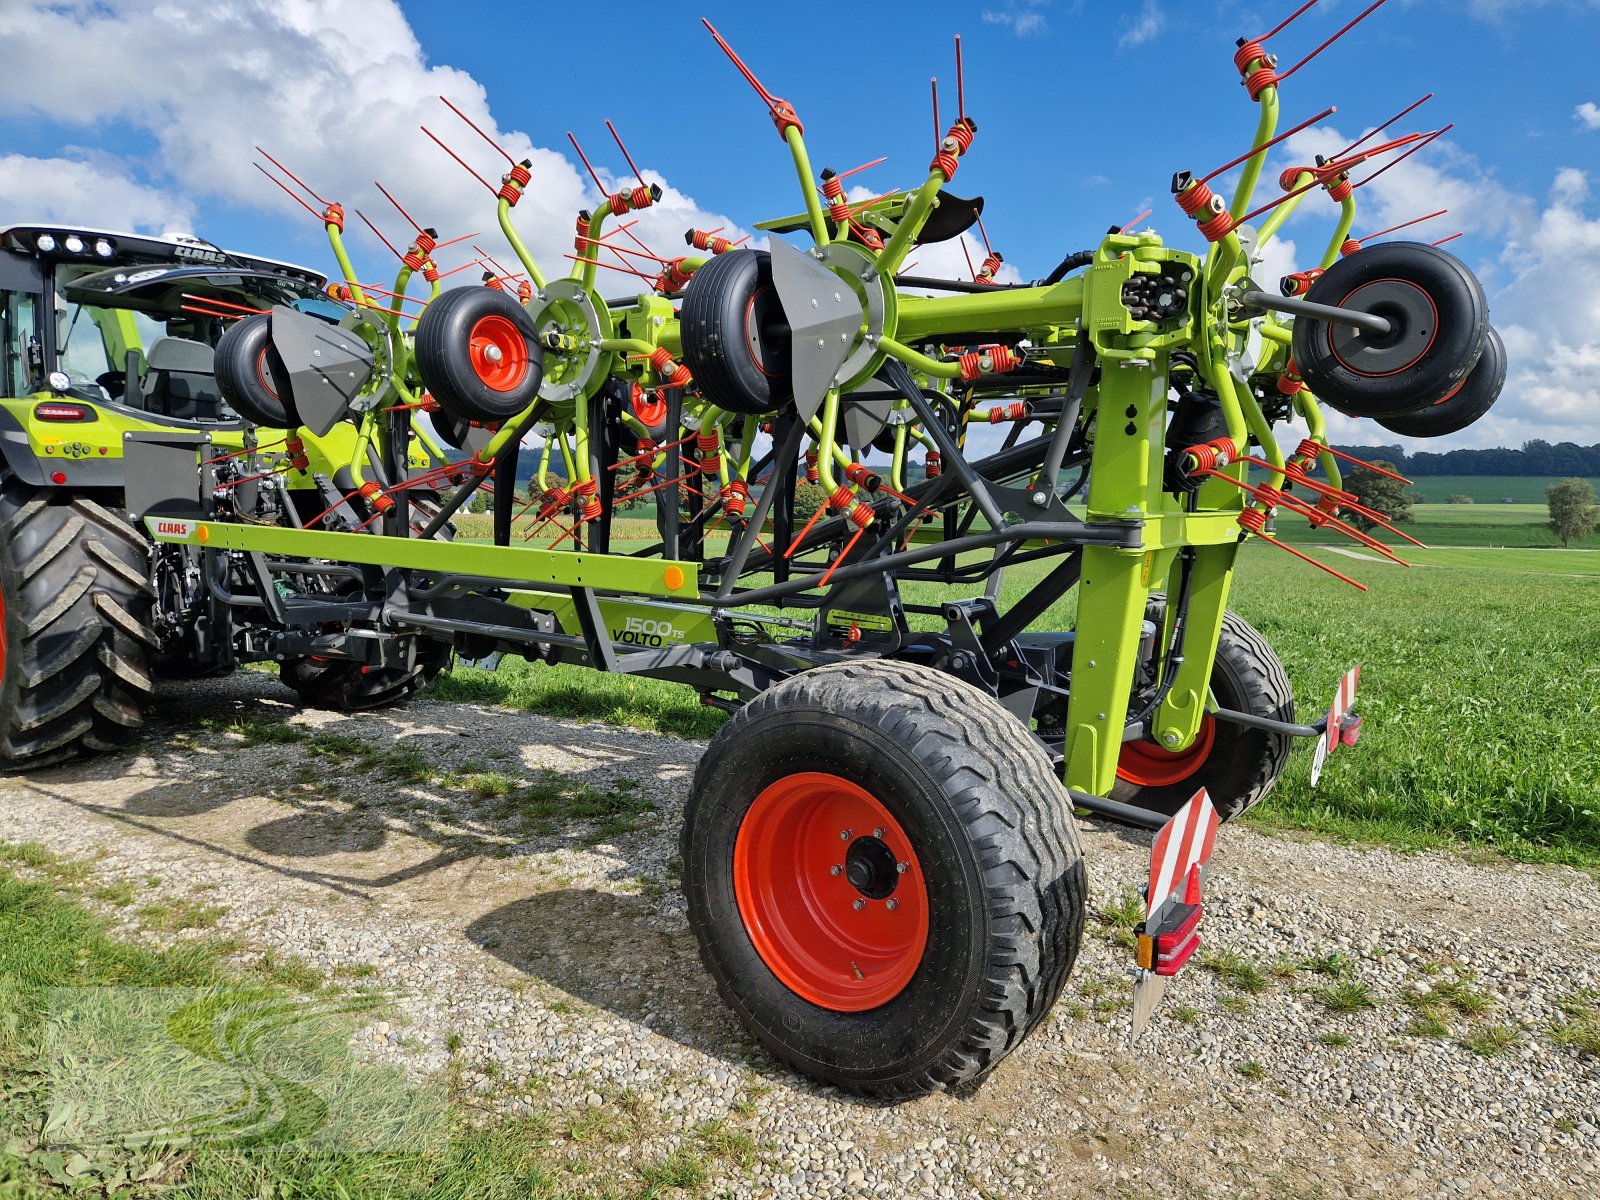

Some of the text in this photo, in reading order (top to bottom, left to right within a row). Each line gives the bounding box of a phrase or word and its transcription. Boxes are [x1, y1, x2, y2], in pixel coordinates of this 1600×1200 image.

[174, 246, 226, 263] CLAAS
[158, 522, 187, 534] CLAAS
[613, 629, 662, 647] VOLTO
